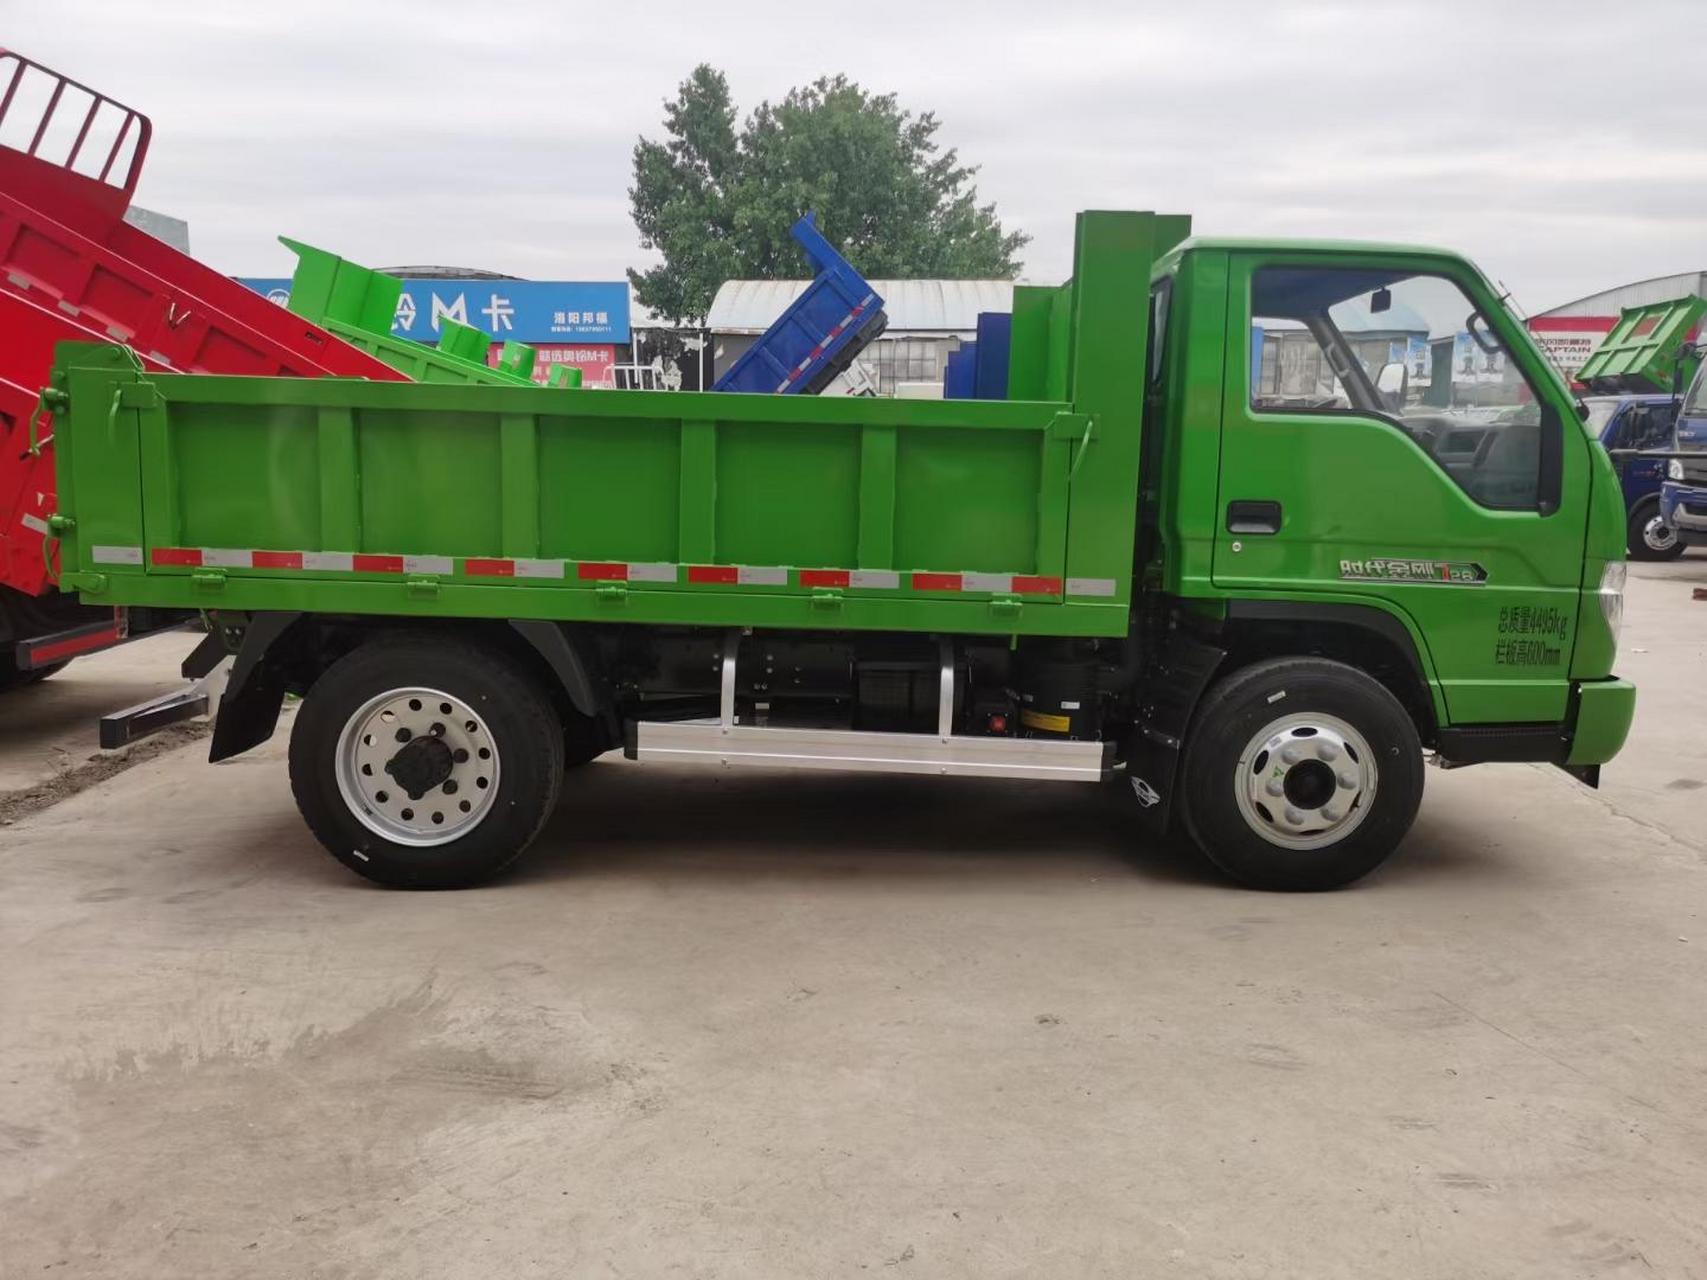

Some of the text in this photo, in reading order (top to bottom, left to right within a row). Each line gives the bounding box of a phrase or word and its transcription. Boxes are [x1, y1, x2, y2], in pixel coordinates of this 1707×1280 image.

[1498, 607, 1567, 640] 总质量4495kg
[1495, 638, 1561, 665] 栏板高600mm
